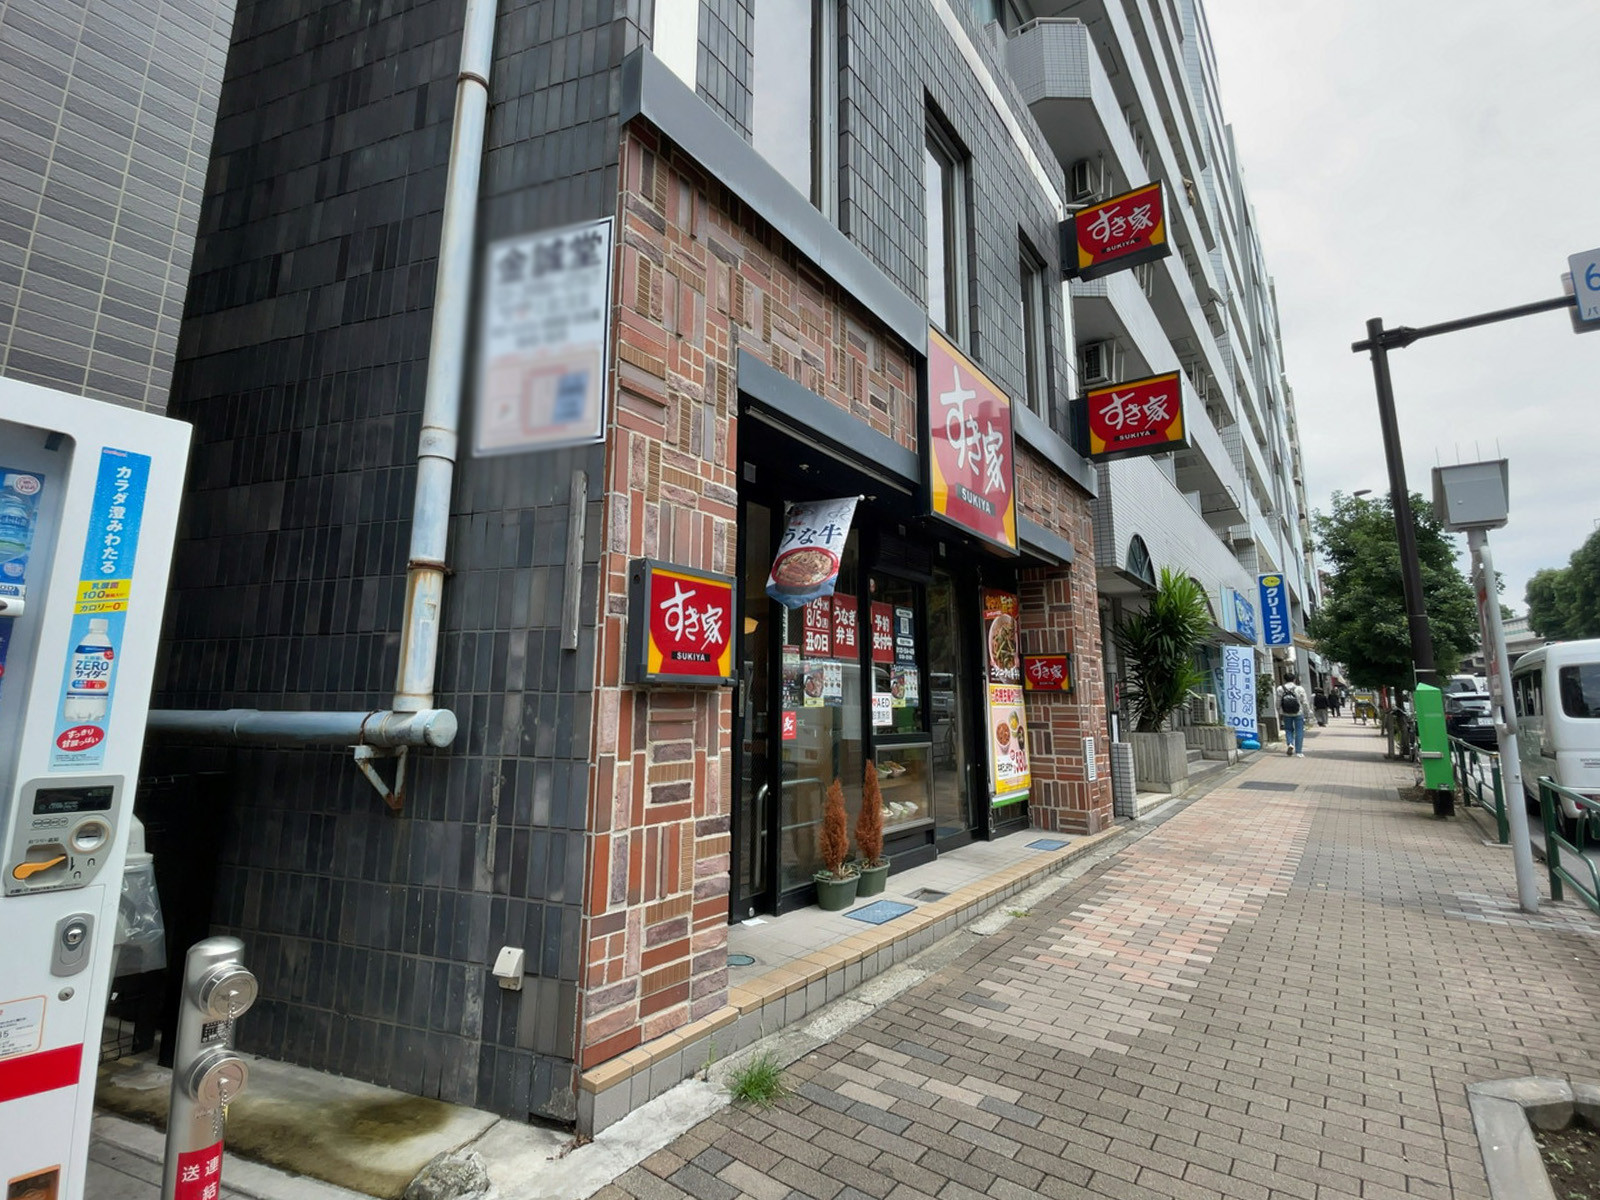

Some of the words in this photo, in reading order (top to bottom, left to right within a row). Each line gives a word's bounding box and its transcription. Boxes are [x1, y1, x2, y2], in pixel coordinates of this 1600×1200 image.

[1087, 203, 1153, 243] すき家
[1105, 239, 1135, 252] SUKIYA
[1099, 392, 1170, 430] すき家
[940, 365, 1006, 495] すき家
[1119, 430, 1151, 441] SUKIYA
[961, 487, 991, 514] SUKIYA
[100, 466, 132, 574] カラダ澄みわたる
[782, 524, 843, 548] うな牛
[660, 581, 723, 651] すき家
[834, 607, 857, 626] うなぎ
[874, 614, 890, 632] 予約
[1266, 587, 1285, 644] クリーニング
[806, 631, 829, 652] 丑の日
[836, 626, 855, 646] 弁当
[75, 660, 109, 671] ZERO
[676, 651, 706, 661] SUKIYA
[75, 670, 107, 679] サイダー
[1029, 659, 1063, 681] すき家
[67, 728, 94, 739] すっきり
[181, 1163, 200, 1182] 送
